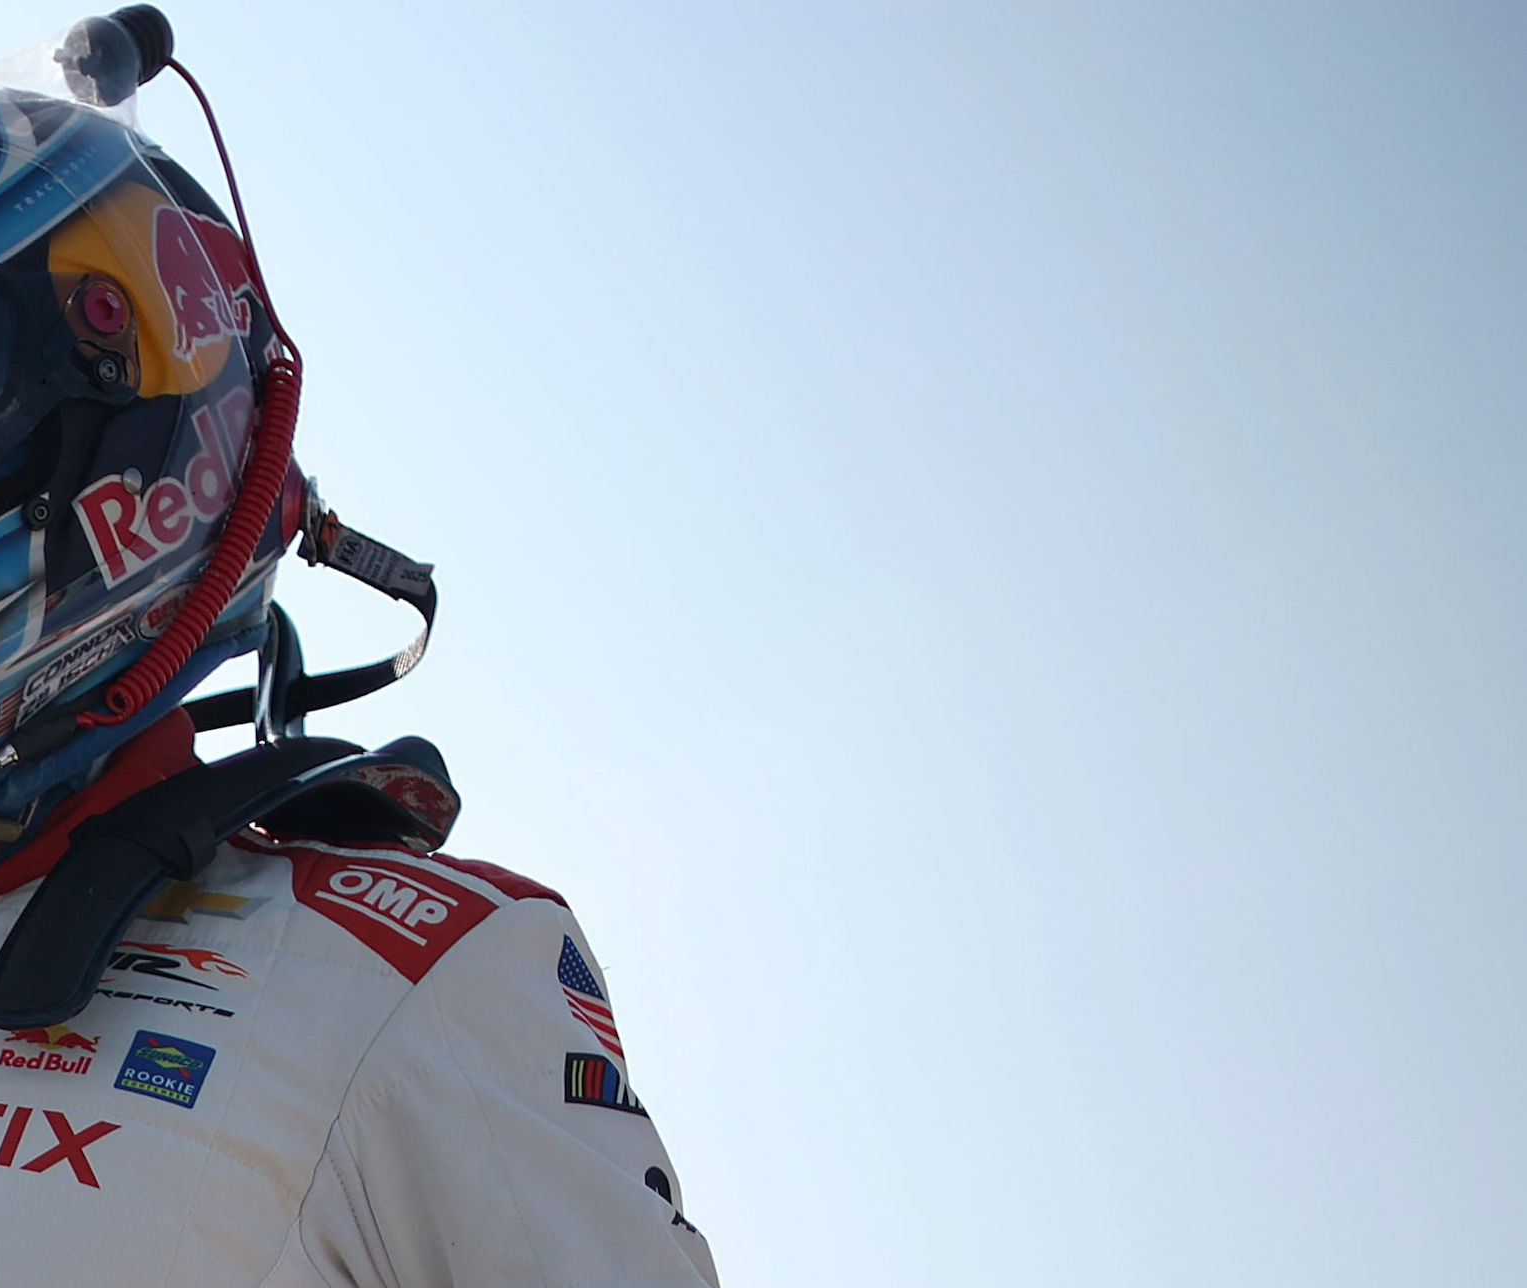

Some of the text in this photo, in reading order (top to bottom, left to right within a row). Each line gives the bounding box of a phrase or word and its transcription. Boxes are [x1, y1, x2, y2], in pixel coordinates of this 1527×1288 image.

[71, 404, 235, 591] Red
[329, 870, 449, 928] OMP
[44, 1052, 92, 1075] Bull
[135, 1046, 205, 1071] SUNOCO
[125, 1067, 195, 1096] ROOKIE
